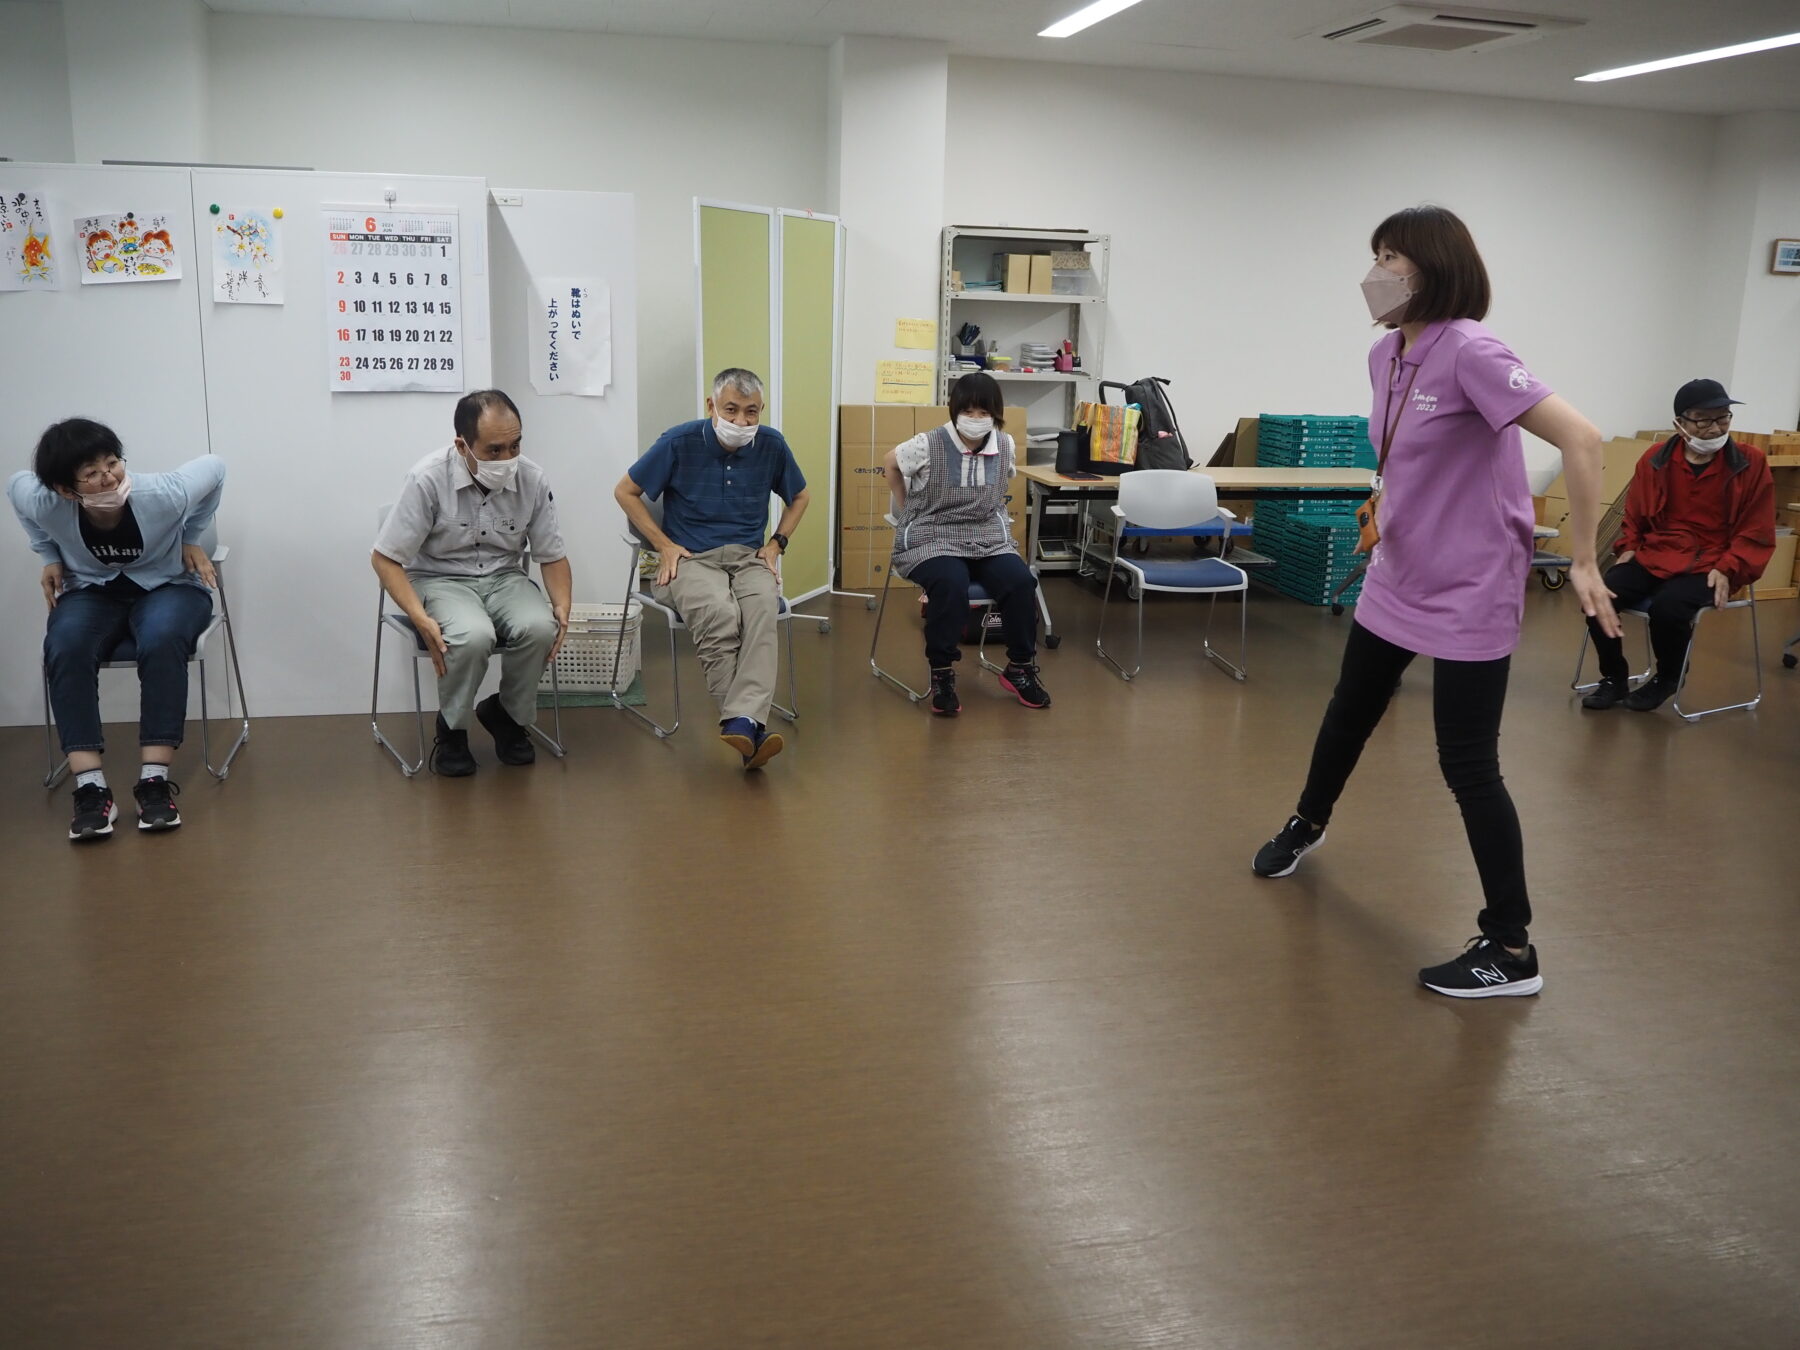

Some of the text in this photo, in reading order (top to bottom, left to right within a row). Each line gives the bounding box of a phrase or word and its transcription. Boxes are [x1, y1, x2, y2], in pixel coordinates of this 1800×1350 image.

[365, 217, 377, 233] 6
[351, 243, 363, 256] 27
[367, 243, 381, 256] 28
[385, 243, 399, 256] 29
[402, 244, 416, 257] 30
[420, 244, 433, 257] 31
[440, 245, 446, 258] 1
[337, 271, 448, 286] 2 3 4 5 6 7 8
[338, 300, 451, 315] 9 10 11 12 13 14 15
[571, 288, 582, 340] 靴はぬいで
[337, 328, 453, 343] 16 17 18 19 20 21 22
[547, 298, 559, 382] 上がってください
[339, 356, 454, 371] 23 24 25 26 27 28 29
[340, 371, 351, 381] 30
